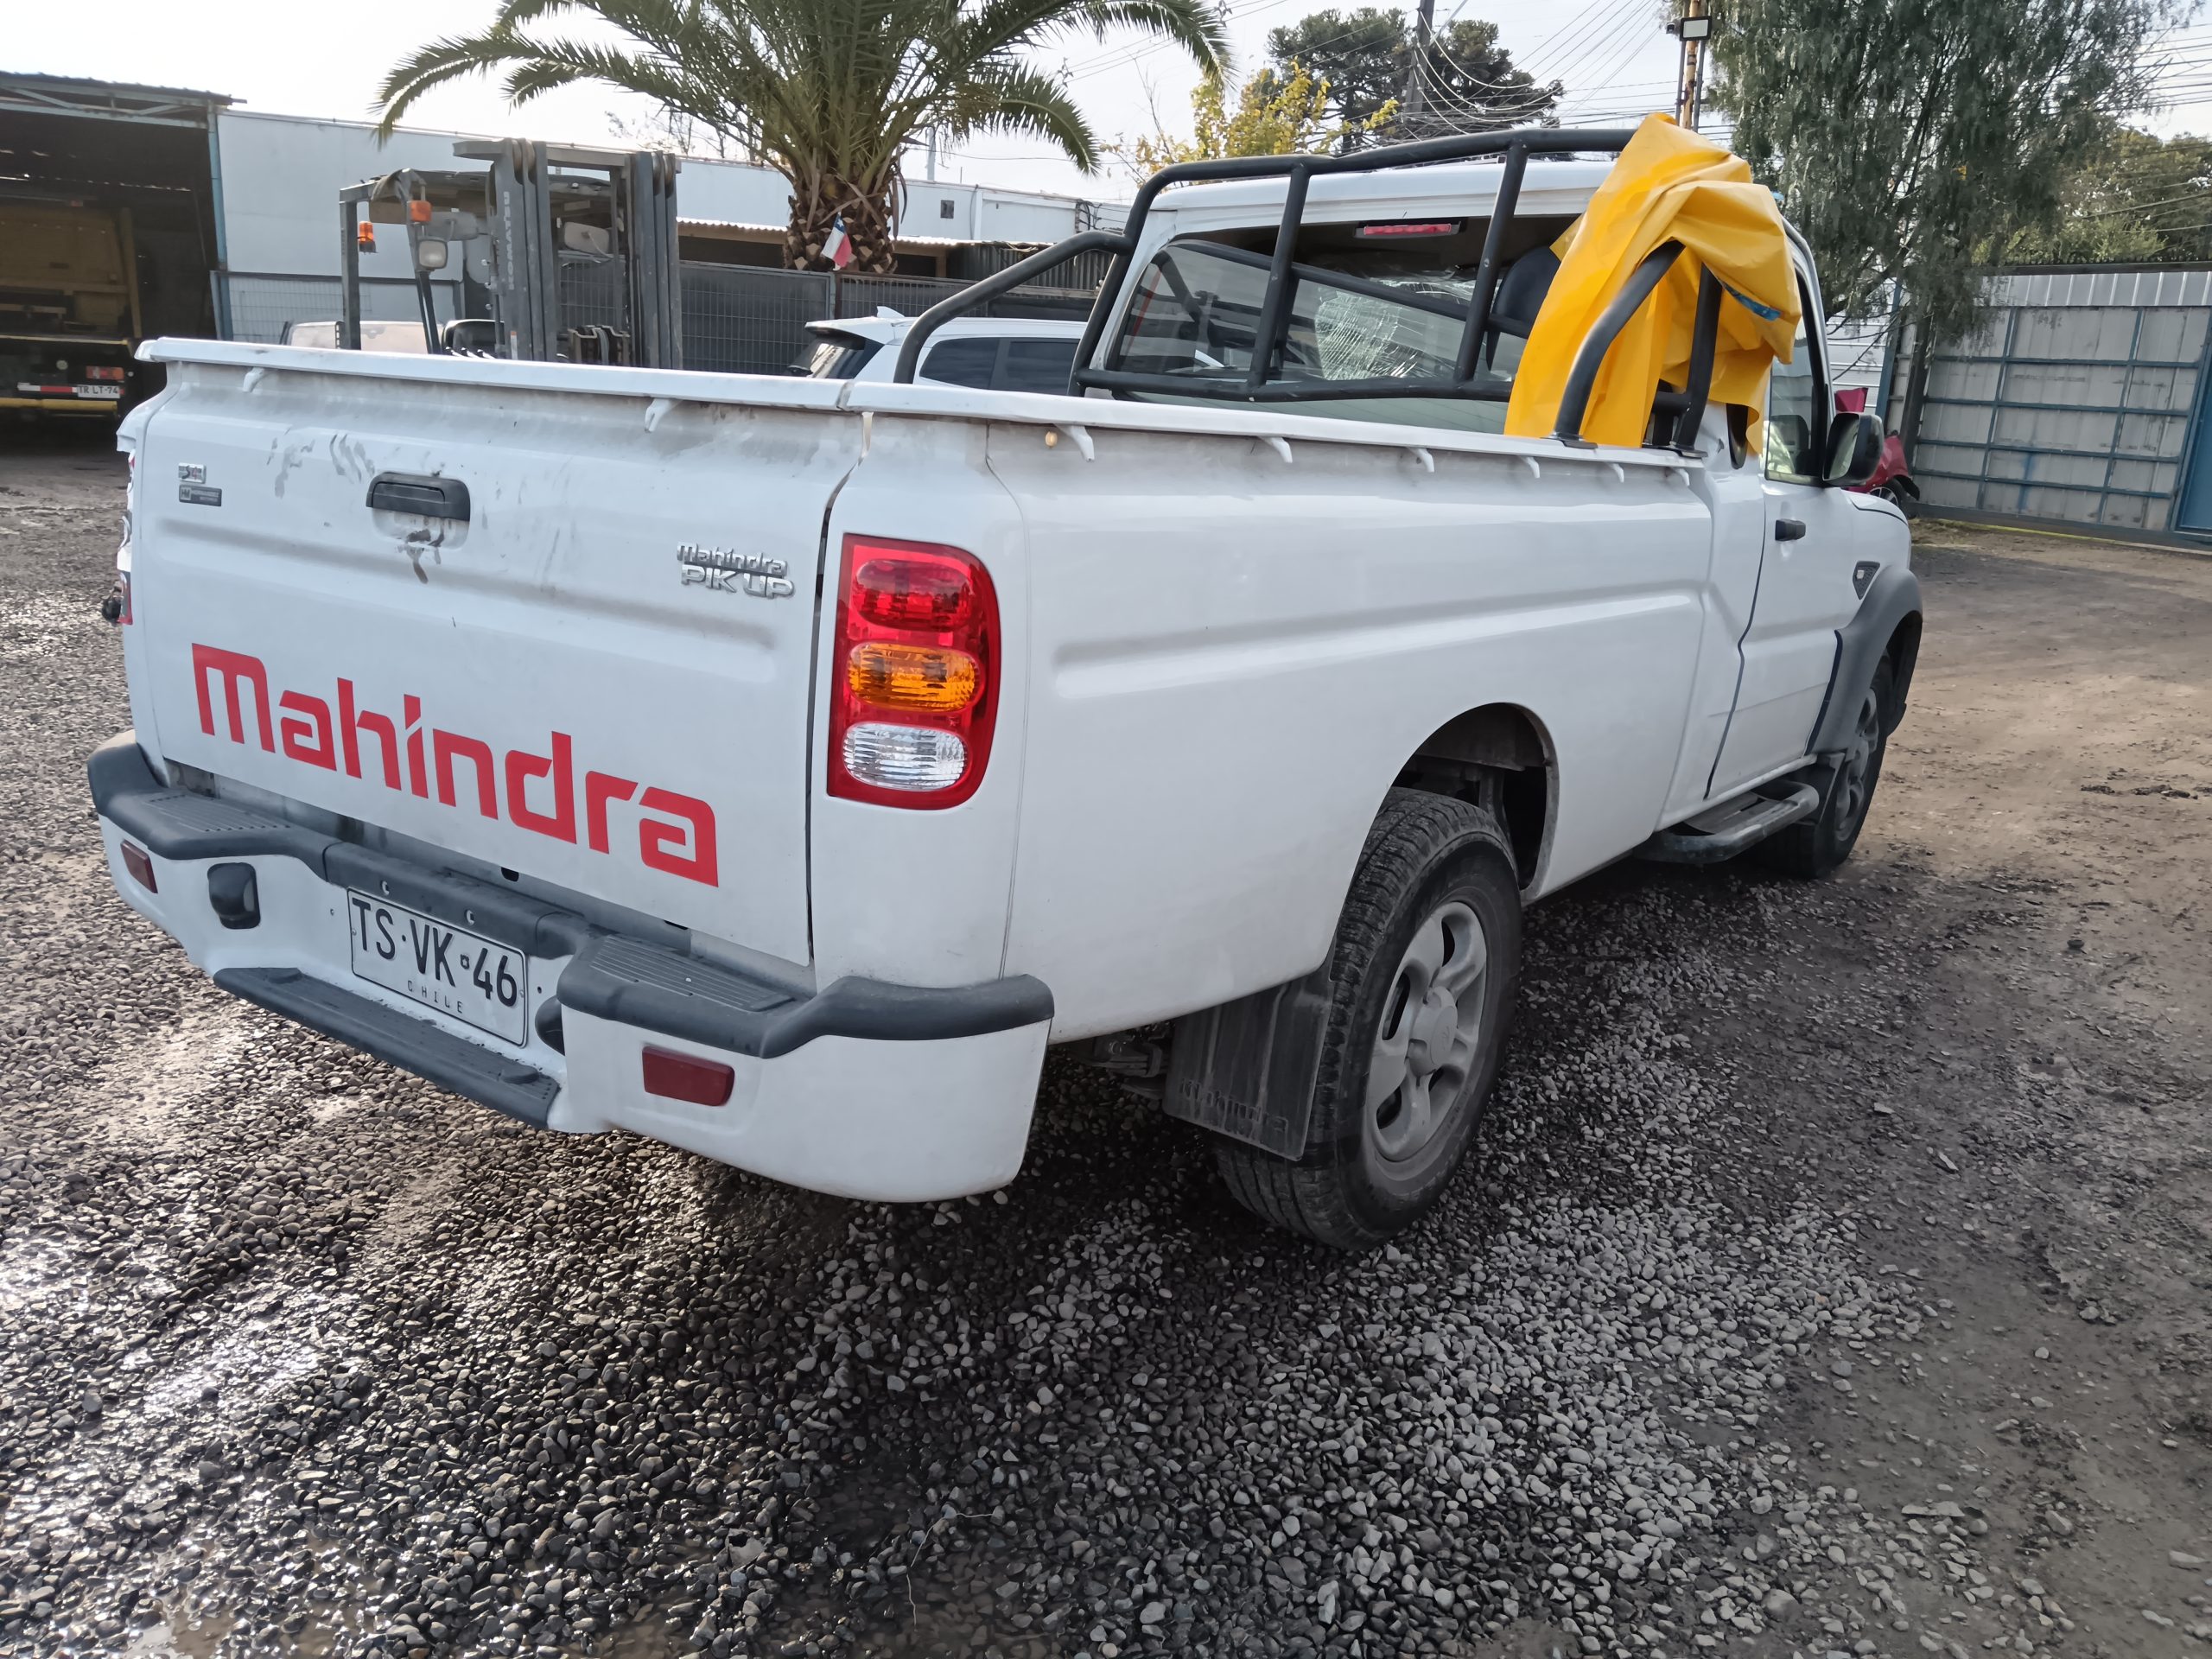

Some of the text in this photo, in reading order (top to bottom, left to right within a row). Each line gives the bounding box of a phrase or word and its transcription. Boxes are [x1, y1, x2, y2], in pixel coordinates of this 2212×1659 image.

[677, 541, 788, 577] Mahindra
[681, 563, 795, 600] PIK UP
[191, 642, 719, 888] Mahindra
[407, 979, 463, 1014] CHILE
